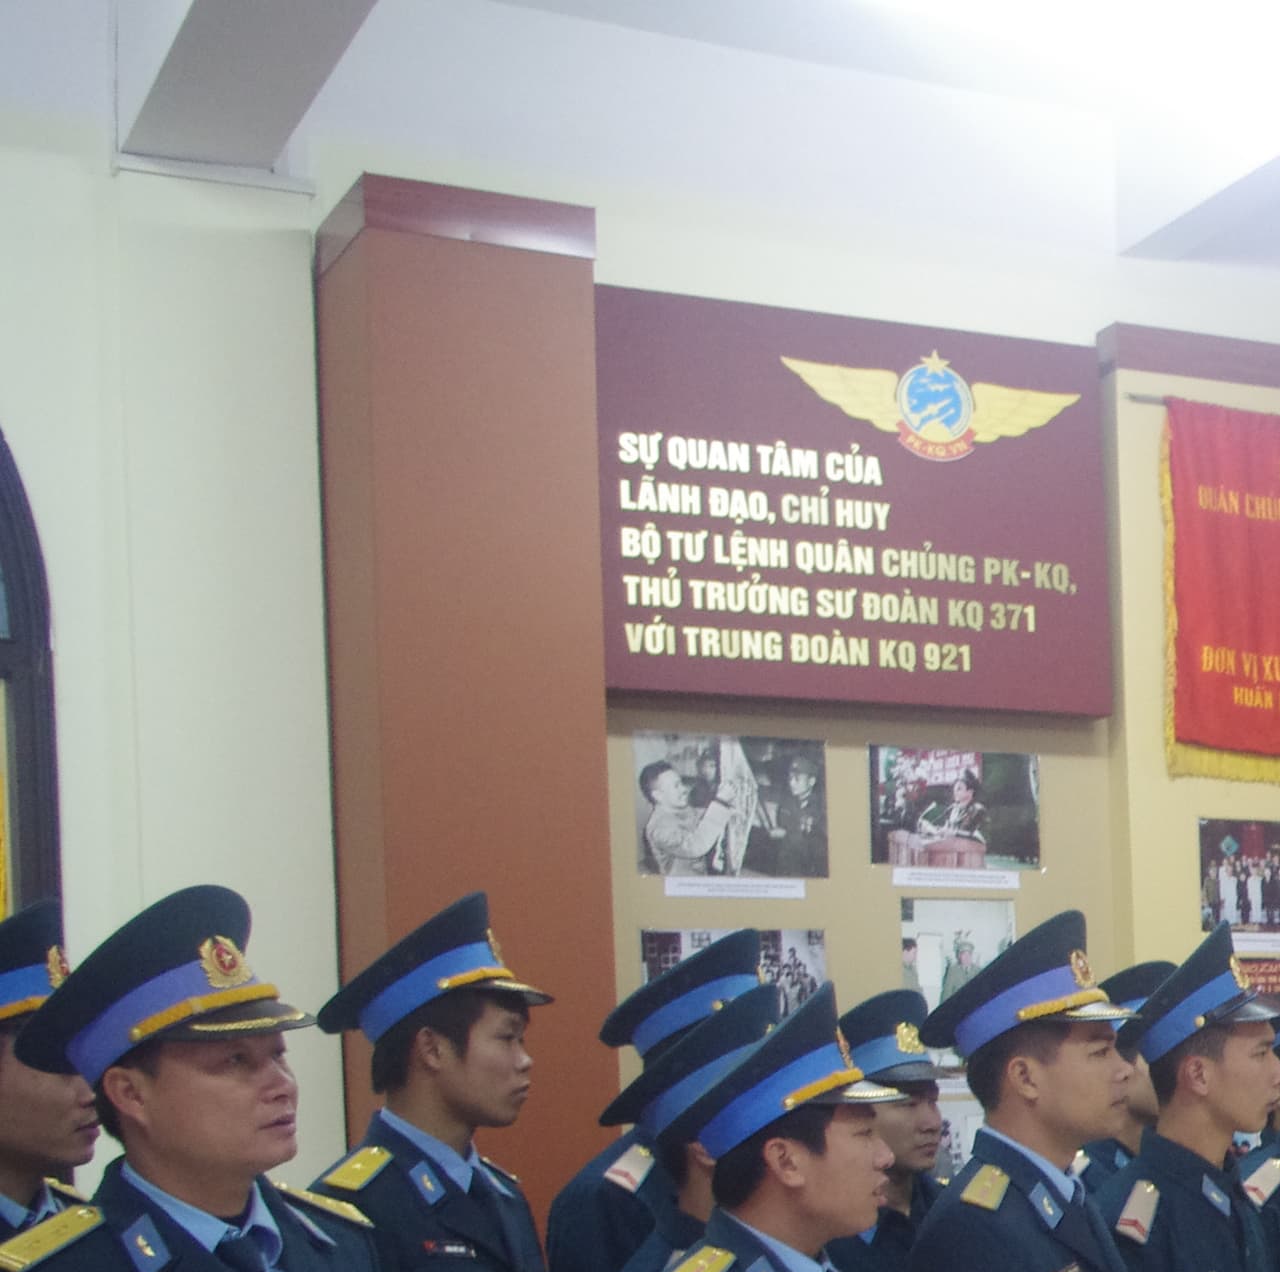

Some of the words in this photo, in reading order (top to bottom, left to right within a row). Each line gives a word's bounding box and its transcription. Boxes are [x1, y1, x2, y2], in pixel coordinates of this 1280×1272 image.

[619, 432, 662, 470] SỰ
[668, 435, 749, 474] QUAN
[757, 440, 818, 478] TÂM
[825, 443, 882, 486] CỦA
[620, 477, 699, 515] LÃNH
[708, 488, 776, 526] ĐẠO,
[782, 487, 830, 526] CHỈ
[836, 500, 890, 531] HUY
[621, 524, 661, 561] BỘ
[667, 530, 708, 561] TƯ
[714, 533, 787, 573] LỆNH
[796, 539, 873, 577] QUÂN
[882, 542, 975, 585] CHỦNG
[624, 568, 682, 609] THỦ
[688, 574, 809, 618] TRƯỞNG
[816, 587, 858, 620] SƯ
[862, 588, 938, 626] ĐOÀN
[948, 602, 984, 631] KQ
[990, 604, 1036, 633] 371
[625, 615, 675, 656] VỚI
[684, 626, 783, 662] TRUNG
[790, 630, 870, 668] ĐOÀN
[879, 639, 916, 673] KQ
[924, 642, 971, 673] 921
